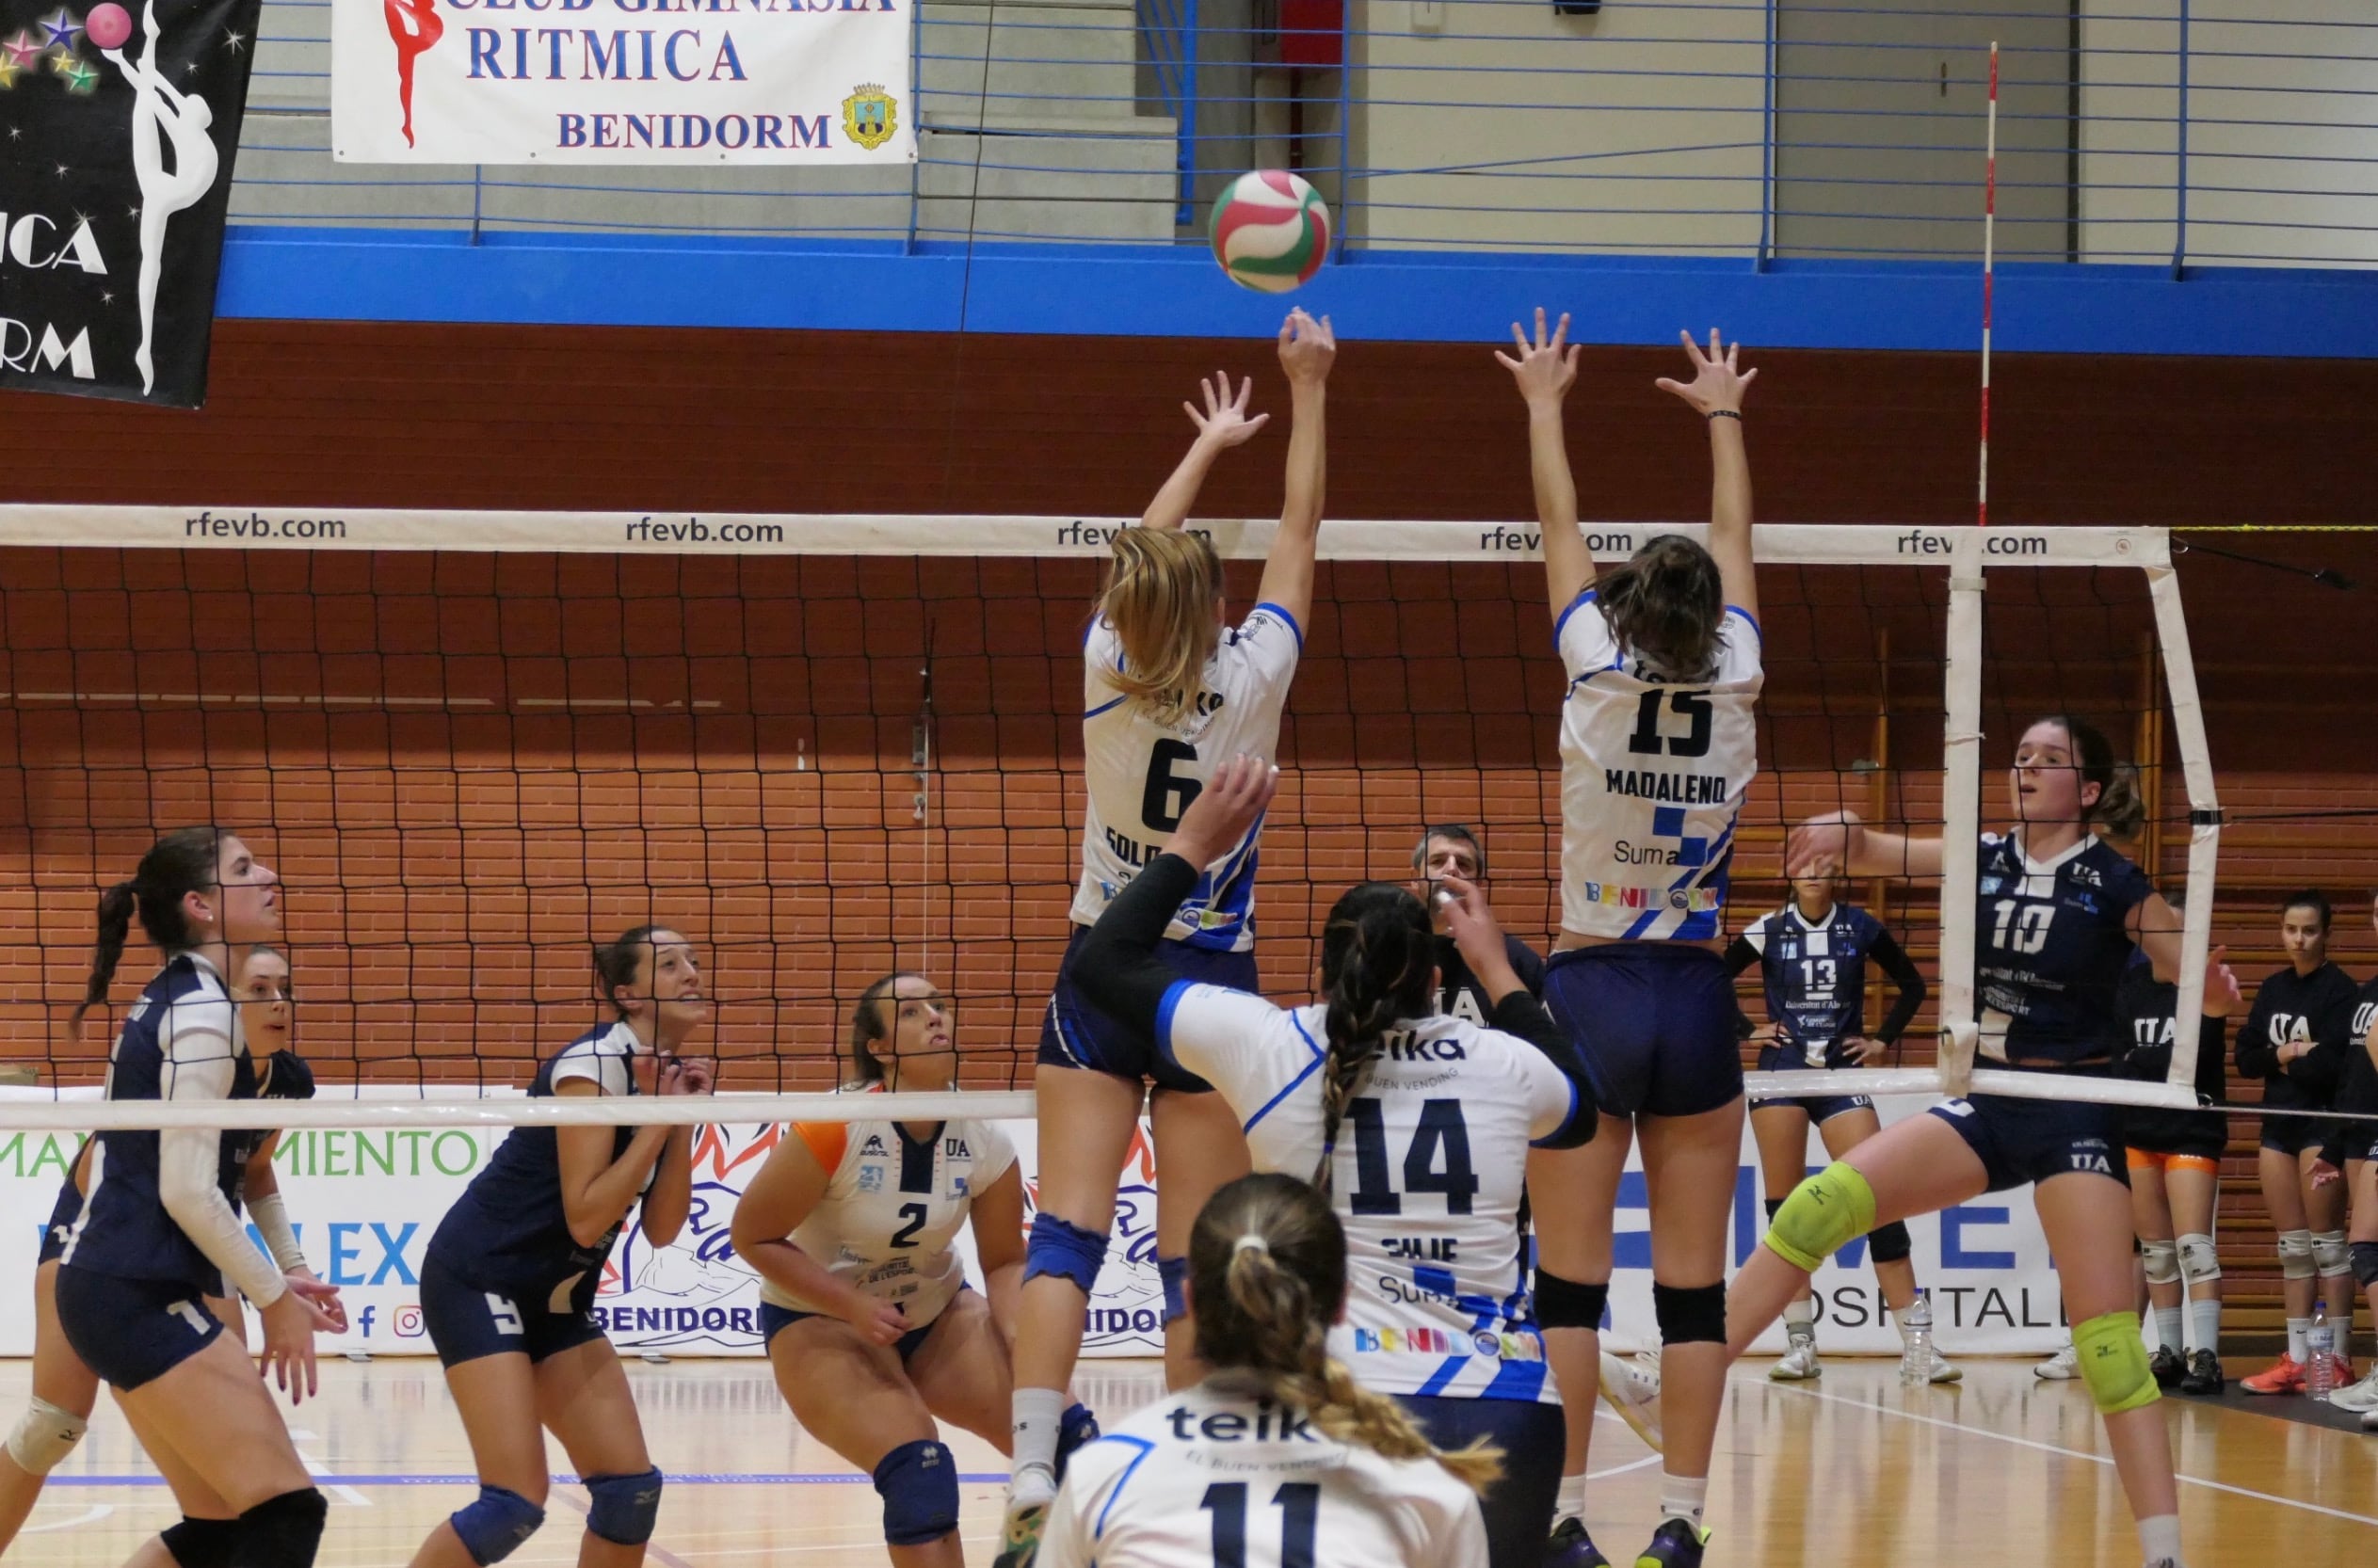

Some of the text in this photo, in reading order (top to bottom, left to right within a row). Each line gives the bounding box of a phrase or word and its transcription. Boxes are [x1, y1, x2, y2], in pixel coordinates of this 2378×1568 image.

[466, 27, 749, 82] RITMICA
[555, 112, 832, 150] BENIDORM
[186, 511, 346, 538] rfevb.com
[626, 516, 783, 543] rfevb.com
[1898, 529, 2048, 554] rfev.com
[1628, 688, 1713, 758] 15
[1142, 738, 1202, 833] 6
[1606, 768, 1727, 805] MADALENO
[1614, 840, 1679, 866] Suma
[1992, 899, 2055, 955] 10
[1800, 959, 1837, 991] 13
[946, 1138, 971, 1157] UA
[1344, 1097, 1480, 1216] 14
[889, 1203, 927, 1249] 2
[1198, 1482, 1321, 1568] 11
